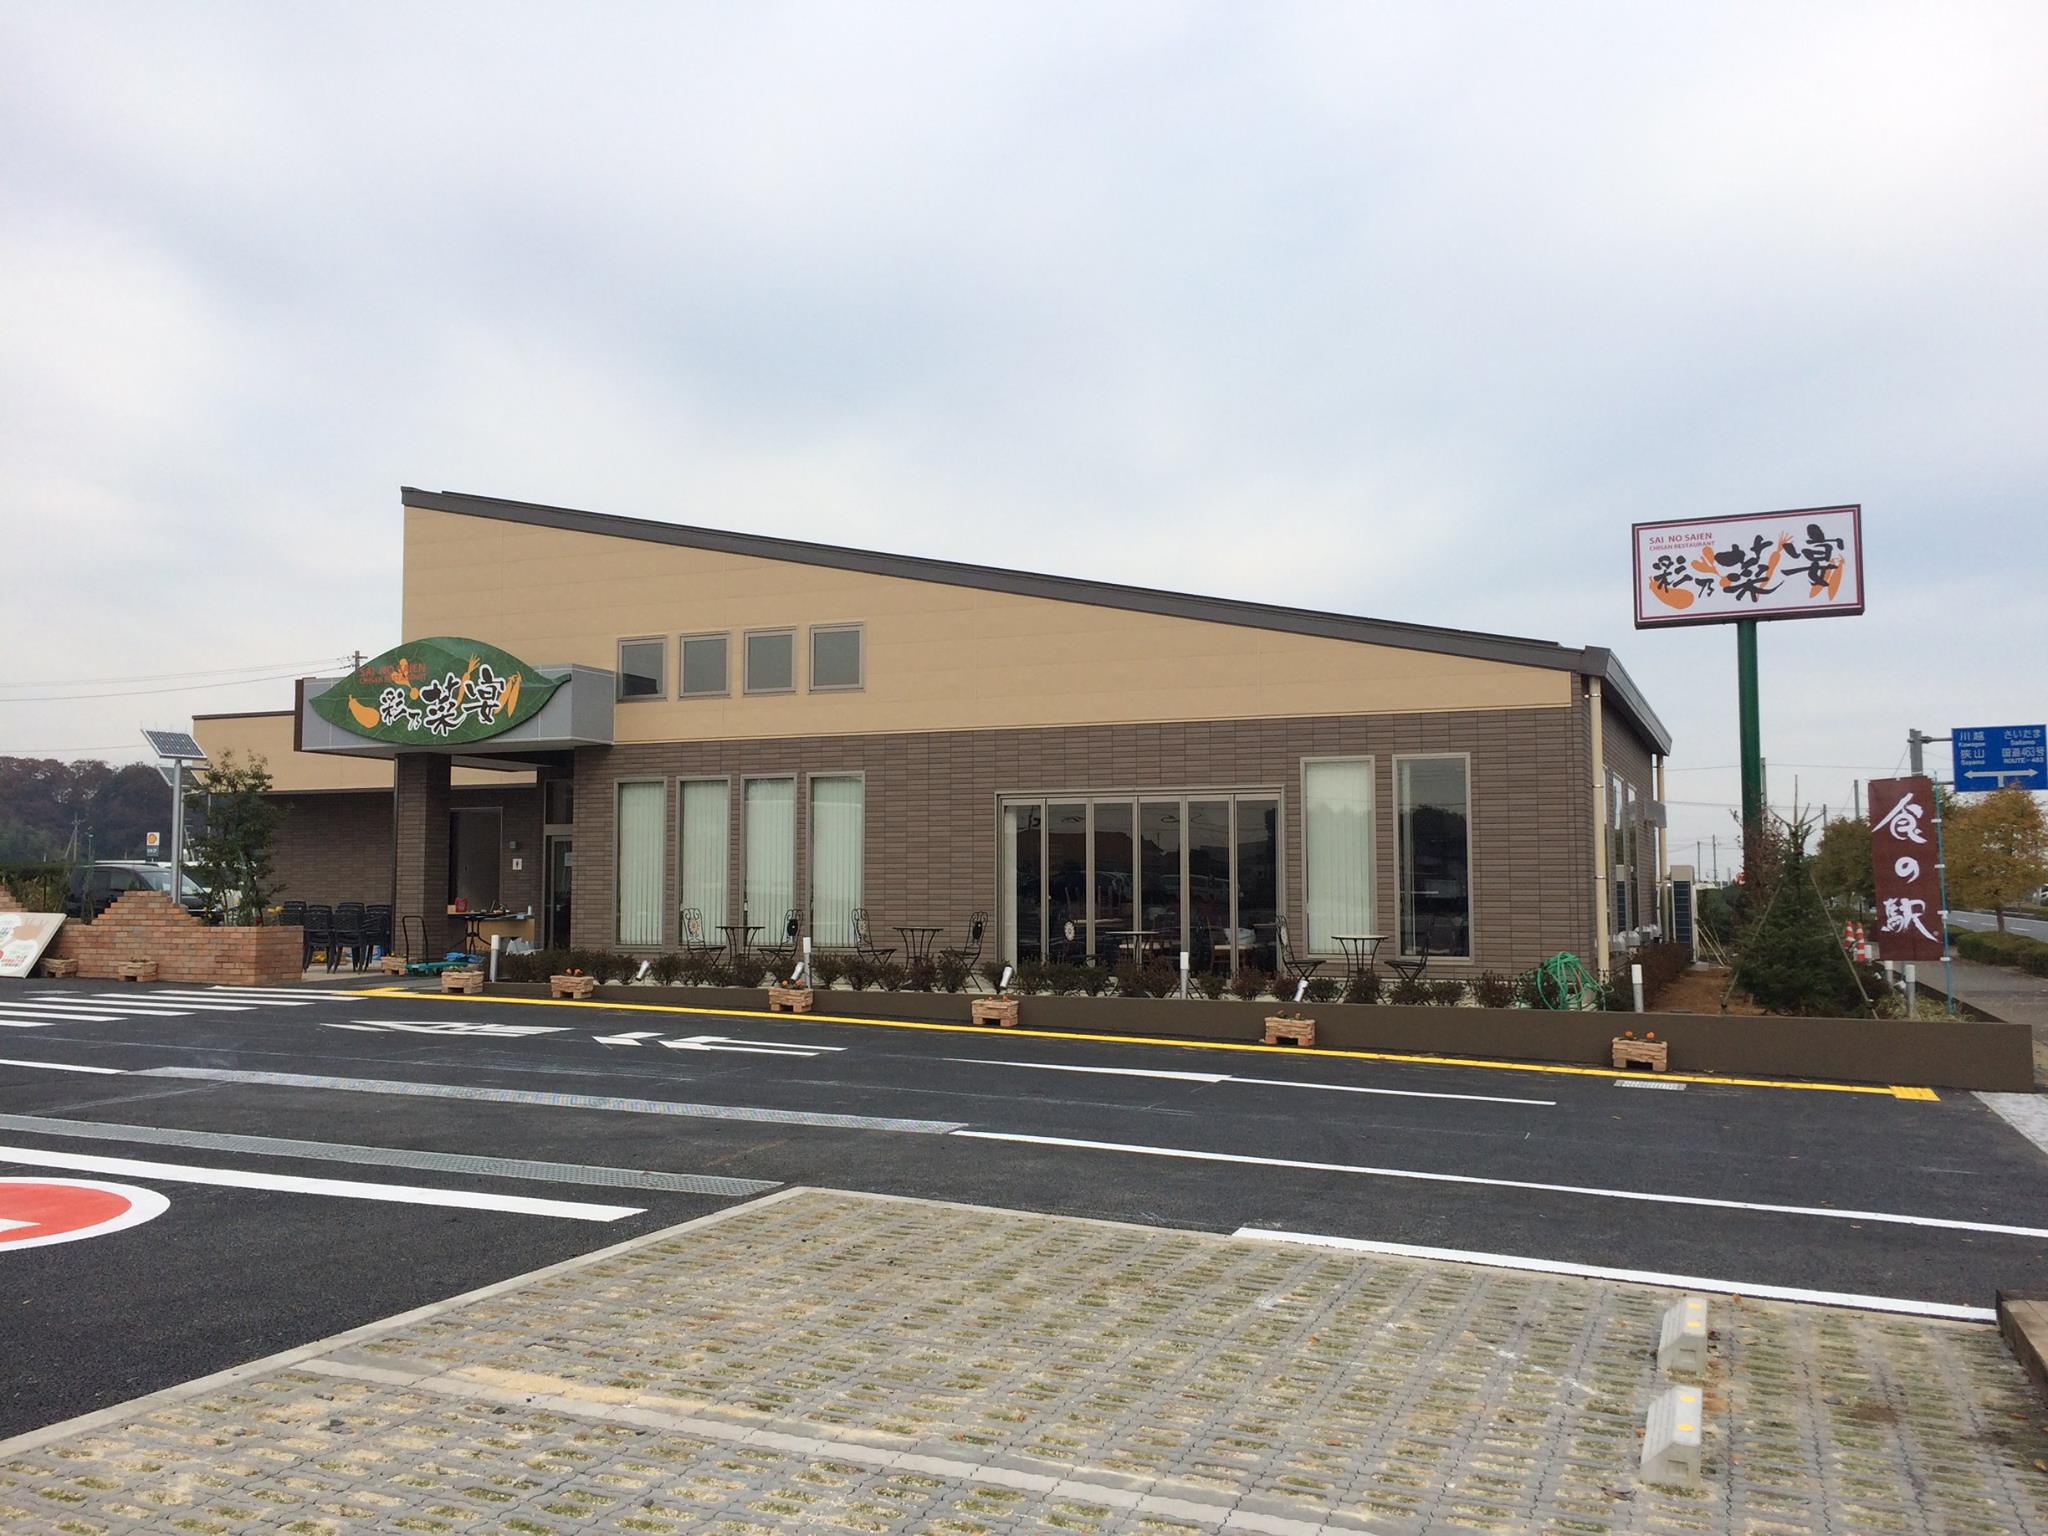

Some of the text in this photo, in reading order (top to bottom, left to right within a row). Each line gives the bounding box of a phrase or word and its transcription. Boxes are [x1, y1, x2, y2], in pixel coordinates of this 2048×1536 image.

[1649, 532, 1713, 545] SAI NO SAIEN
[1674, 540, 1715, 549] RESTAURANT
[2004, 729, 2041, 739] さいたま
[1872, 792, 1939, 942] 食の駅
